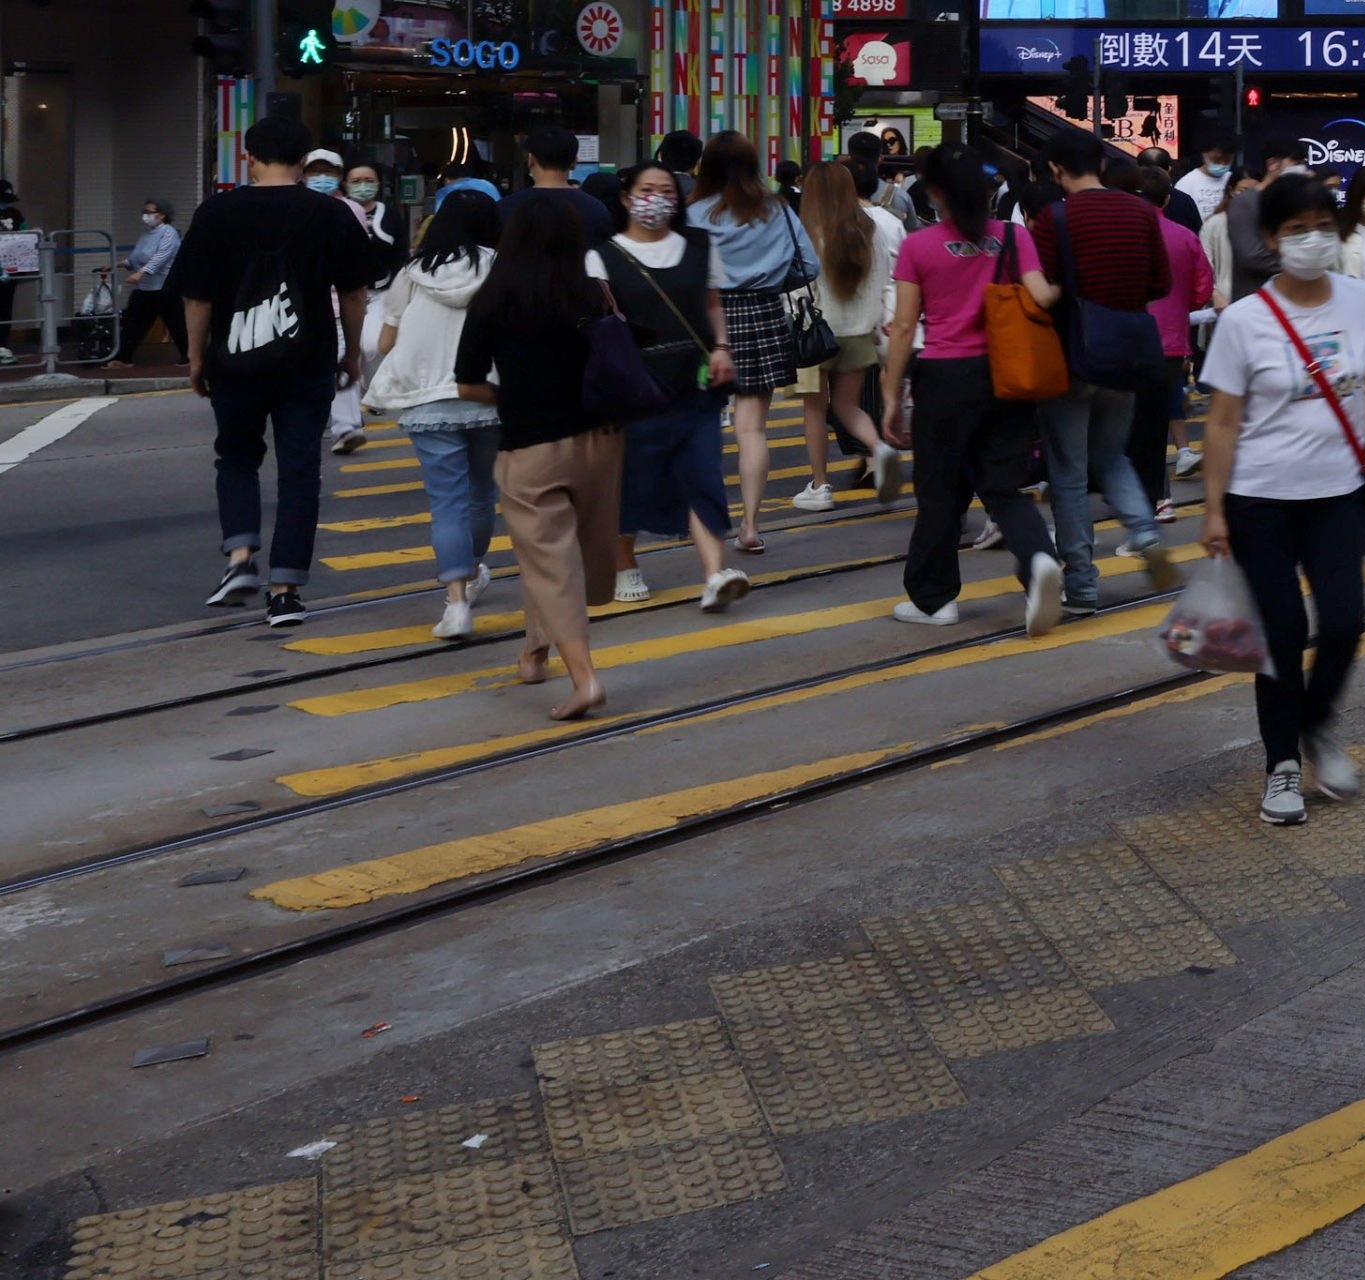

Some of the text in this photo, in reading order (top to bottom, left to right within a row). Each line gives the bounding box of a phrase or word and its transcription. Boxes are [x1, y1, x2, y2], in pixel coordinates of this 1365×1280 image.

[430, 37, 521, 70] SOGO
[861, 53, 890, 66] Sasa
[1015, 45, 1062, 63] Disney+
[1098, 31, 1263, 69] 倒數14天
[227, 280, 300, 355] NIKE
